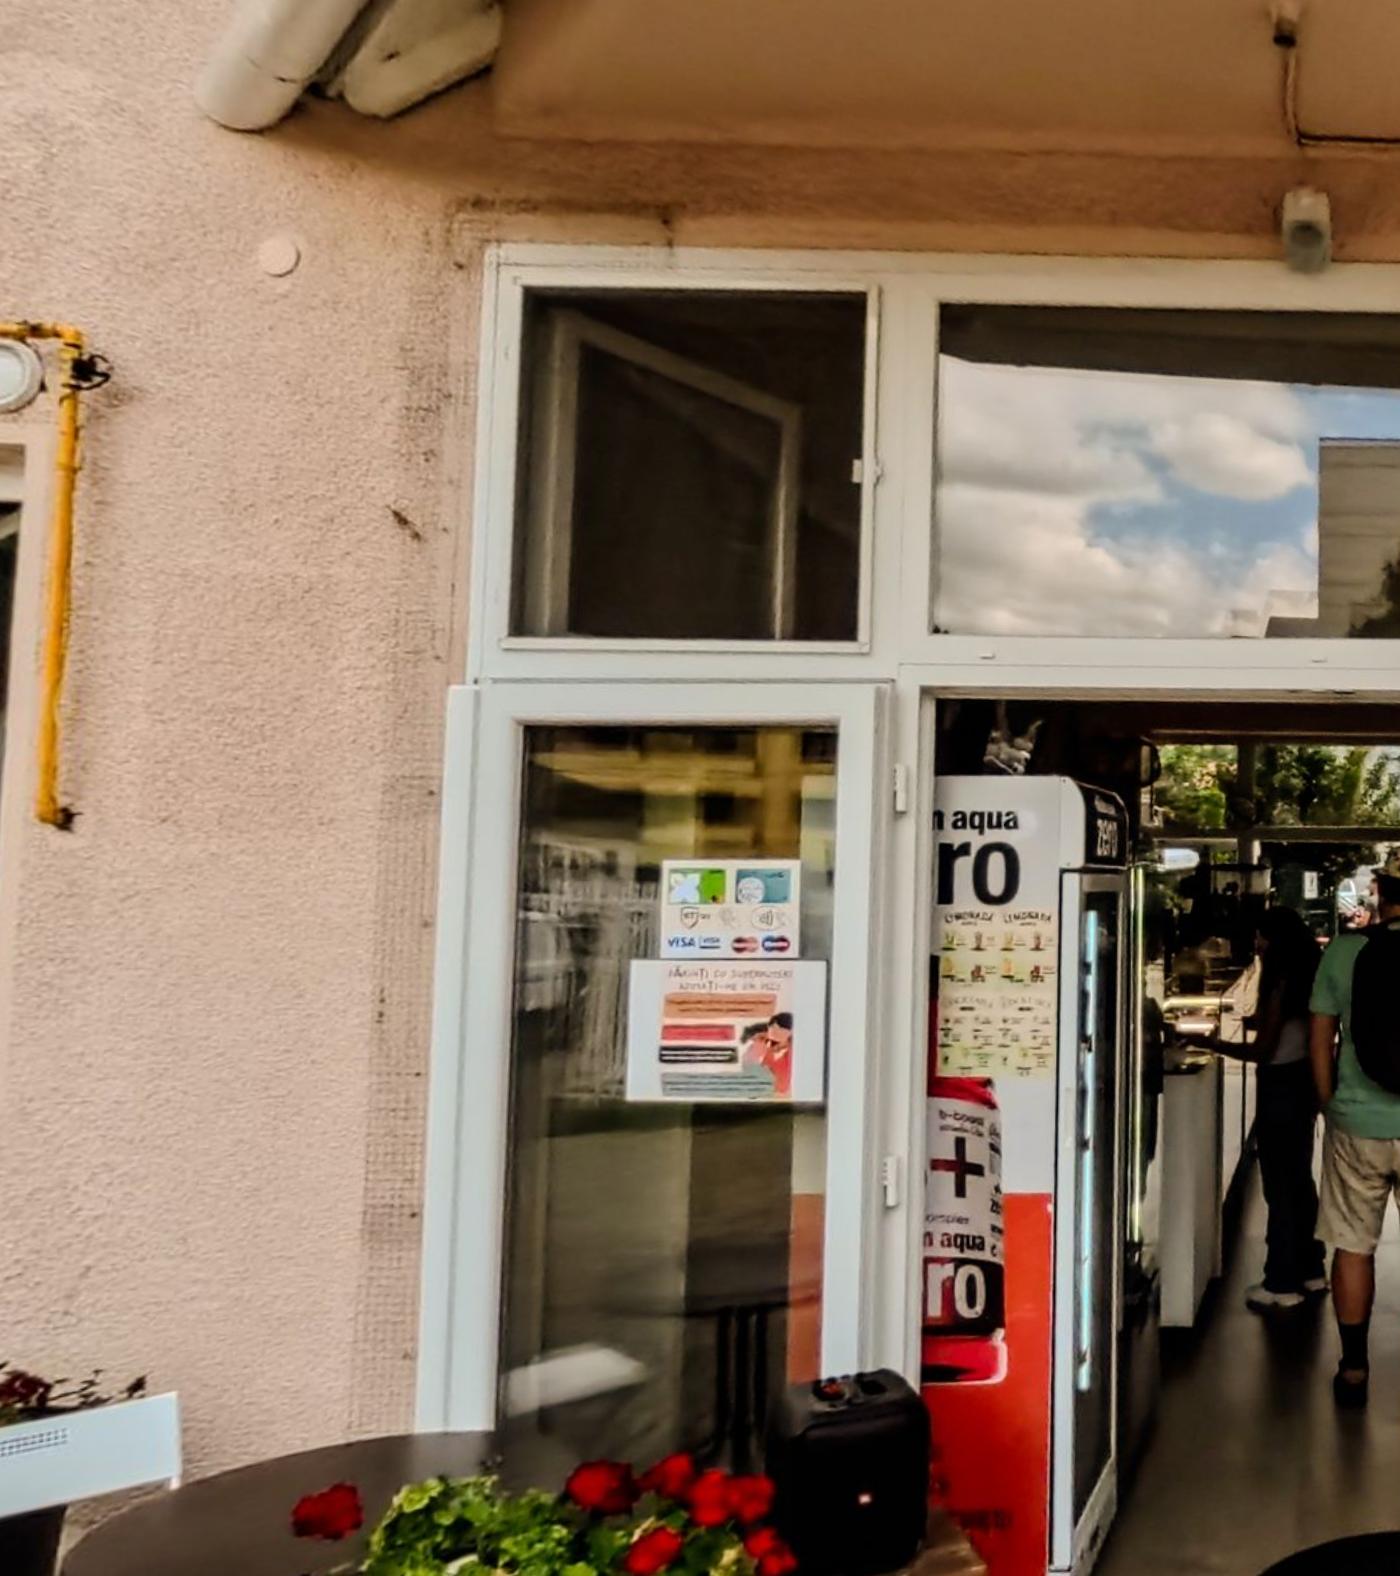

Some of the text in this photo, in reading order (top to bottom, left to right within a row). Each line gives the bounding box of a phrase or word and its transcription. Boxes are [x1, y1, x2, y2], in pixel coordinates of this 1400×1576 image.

[951, 810, 1019, 835] aqua
[667, 936, 696, 948] VISA
[940, 1233, 985, 1253] aqua
[927, 1263, 986, 1319] ro
